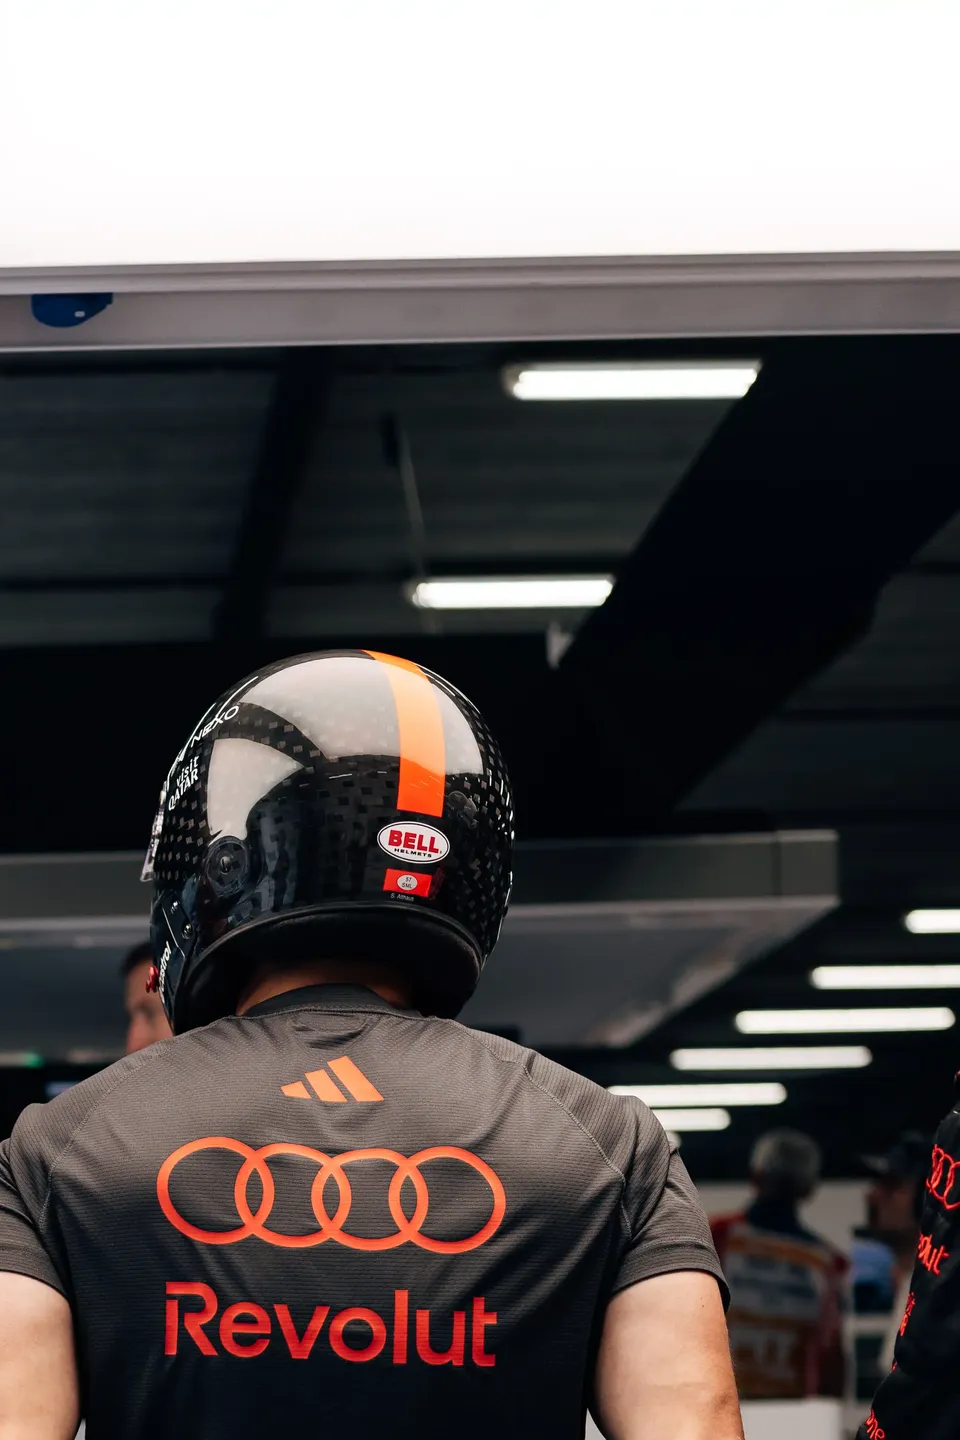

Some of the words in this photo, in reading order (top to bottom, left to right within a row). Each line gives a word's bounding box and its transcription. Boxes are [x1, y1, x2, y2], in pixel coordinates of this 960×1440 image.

[191, 705, 240, 748] NEXO
[168, 768, 199, 811] QATAR
[176, 756, 200, 787] visit
[388, 829, 439, 854] BELL
[393, 848, 433, 858] HELMETS
[164, 1281, 498, 1367] Revolut
